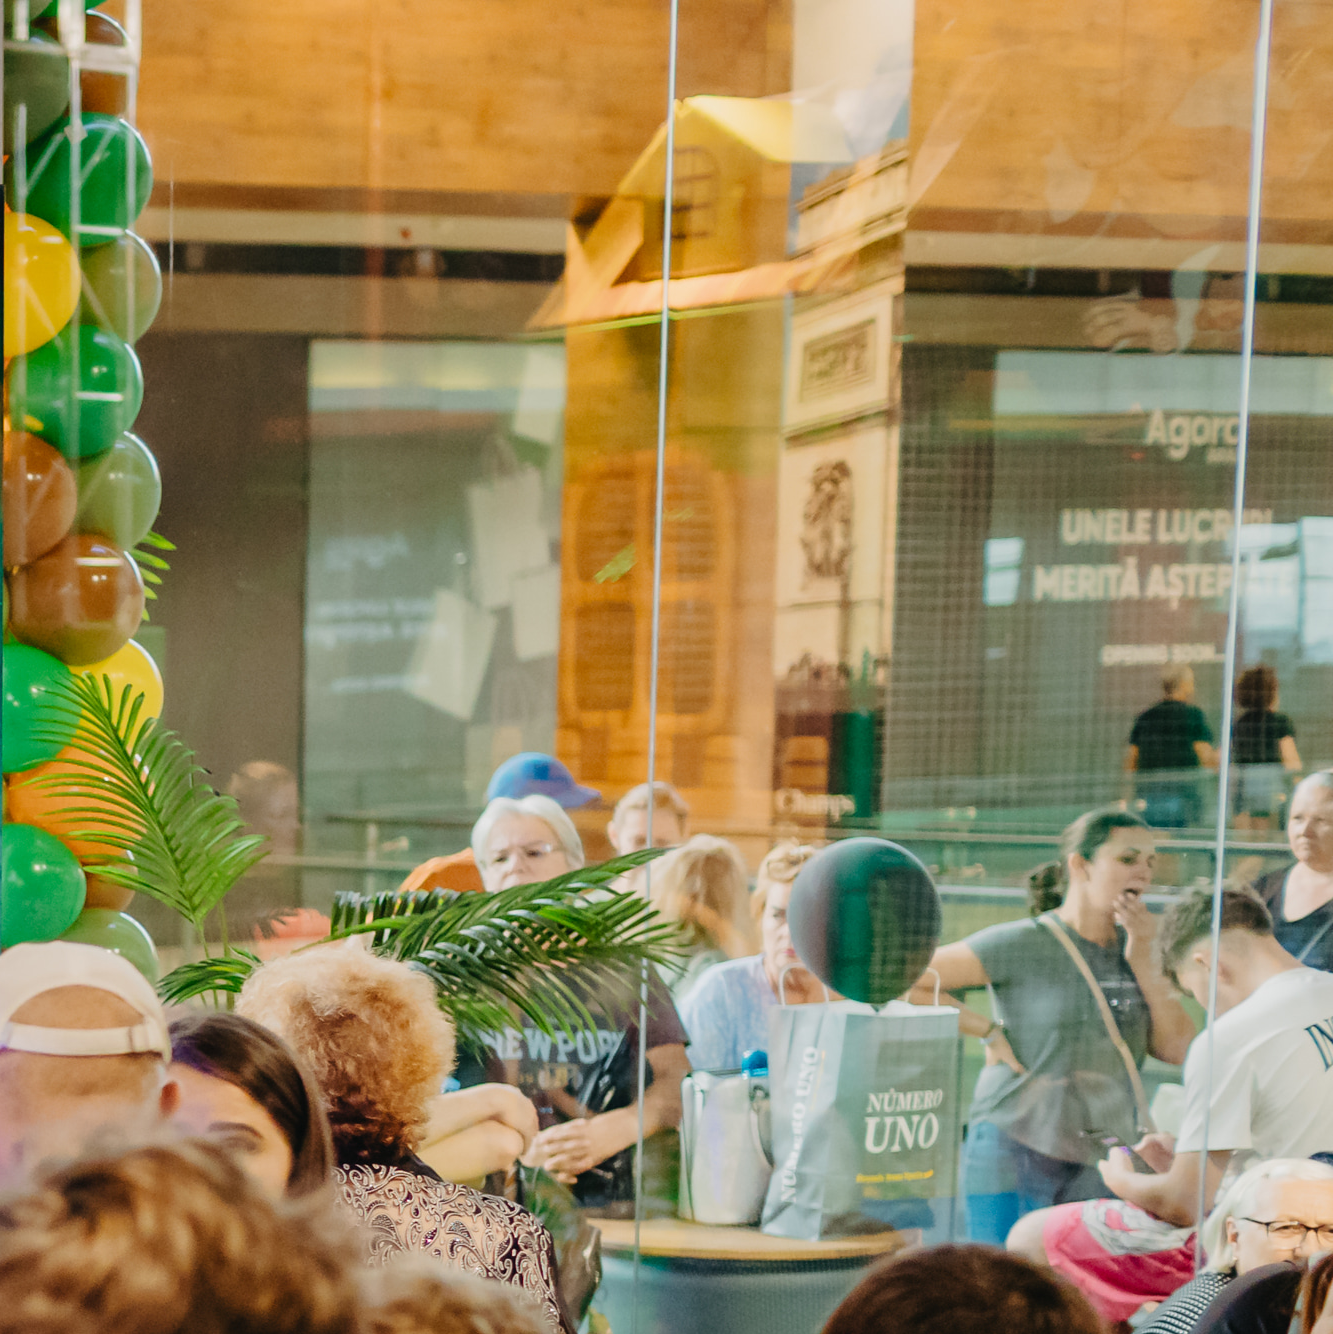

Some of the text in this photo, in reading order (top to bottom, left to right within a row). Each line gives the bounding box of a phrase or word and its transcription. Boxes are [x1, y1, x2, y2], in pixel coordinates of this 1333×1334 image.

[1061, 509, 1152, 544] UNELE
[479, 1026, 625, 1063] NEWPOR
[864, 1112, 939, 1154] UNO
